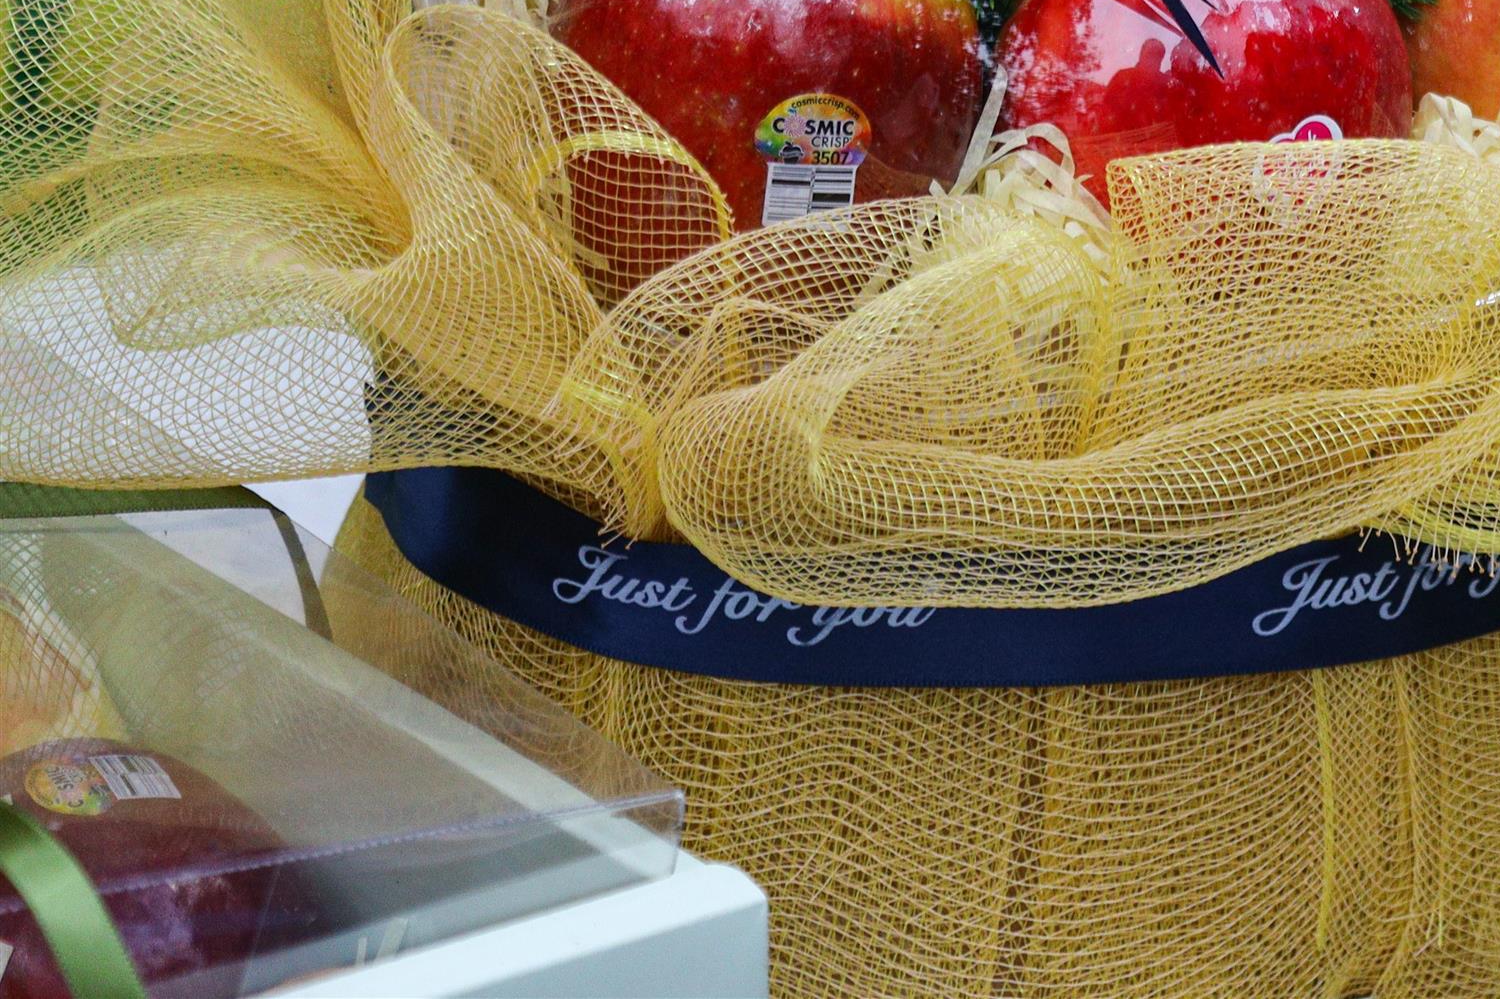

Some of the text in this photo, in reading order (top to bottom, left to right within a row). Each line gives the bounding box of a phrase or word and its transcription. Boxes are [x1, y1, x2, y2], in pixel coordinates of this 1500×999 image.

[791, 96, 860, 120] cosmiccrisp.com
[811, 136, 850, 149] CRISP
[811, 149, 849, 165] 3507
[552, 545, 697, 612] Just
[675, 577, 801, 635] for
[1252, 554, 1400, 637] Just
